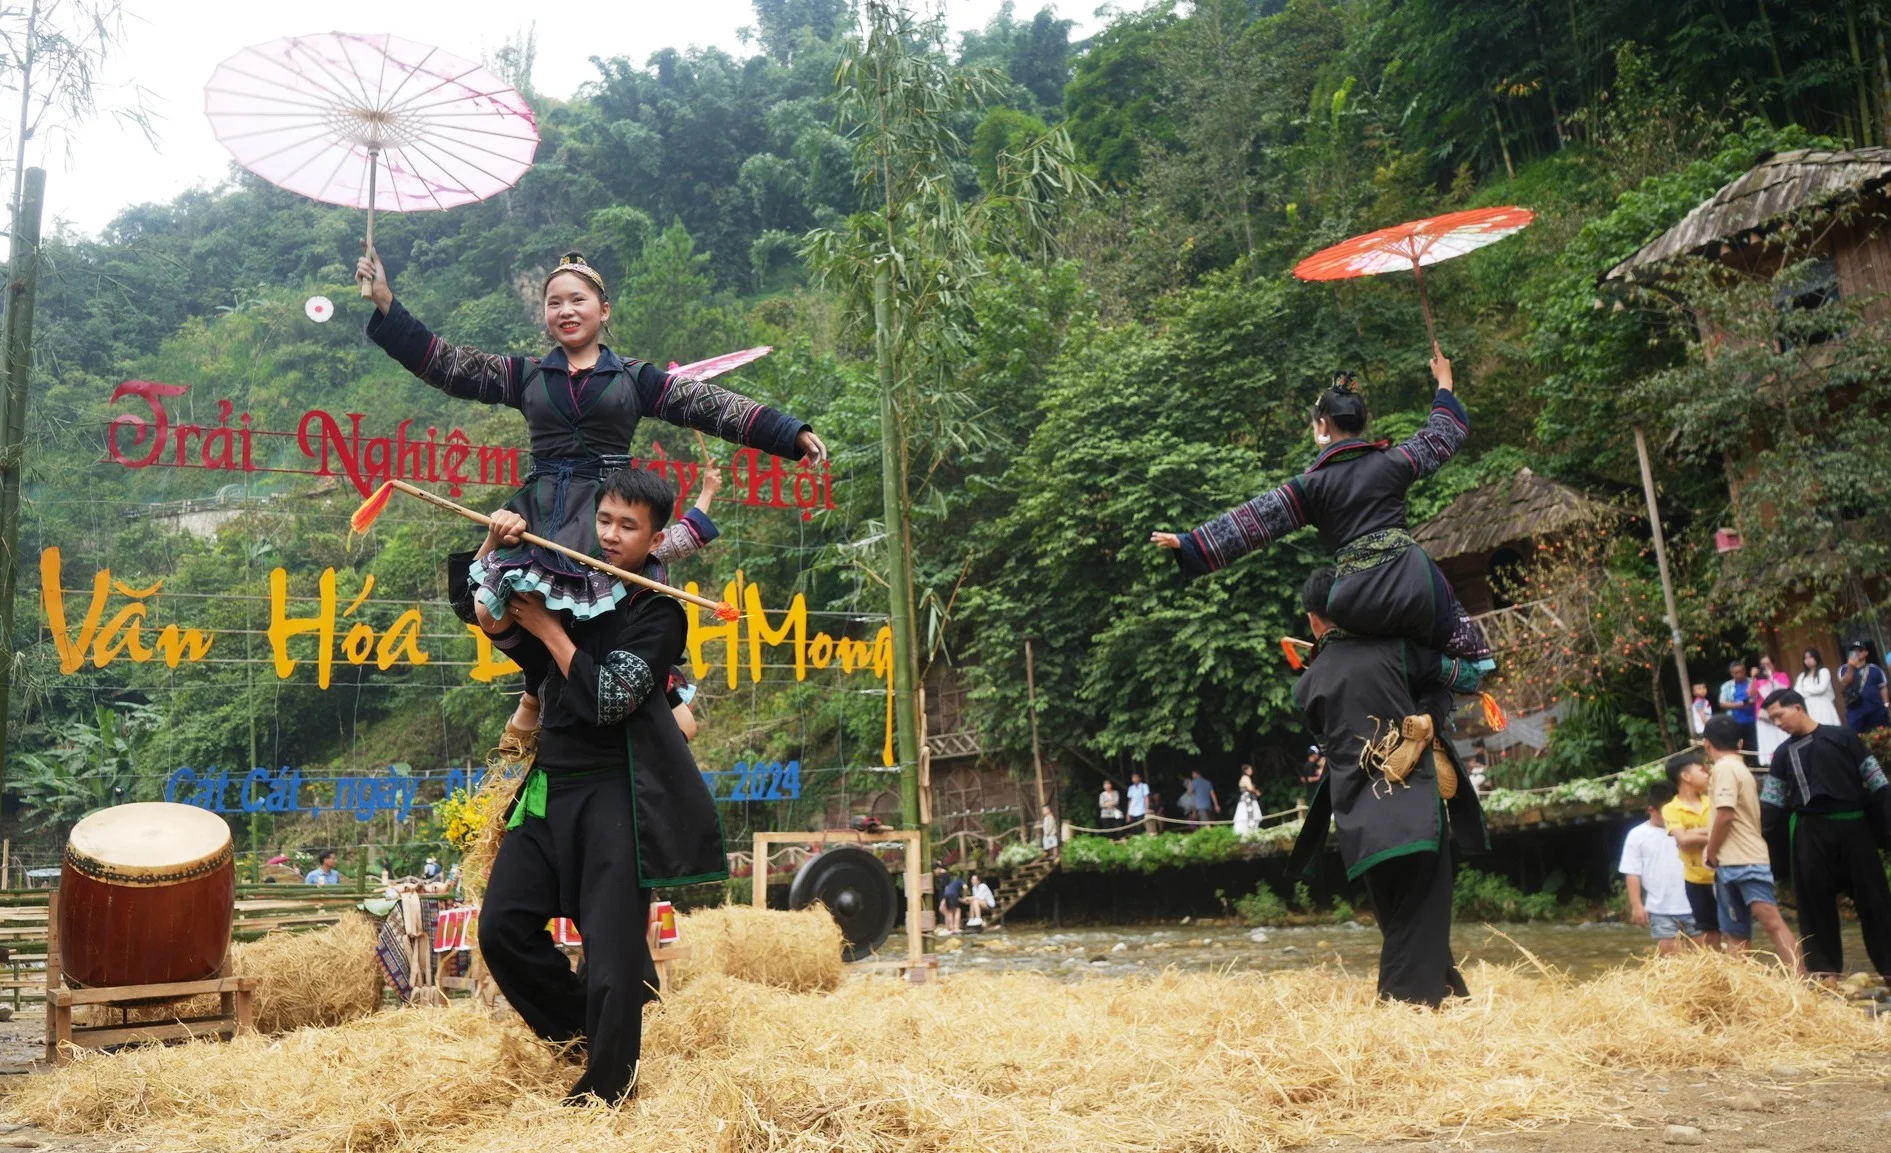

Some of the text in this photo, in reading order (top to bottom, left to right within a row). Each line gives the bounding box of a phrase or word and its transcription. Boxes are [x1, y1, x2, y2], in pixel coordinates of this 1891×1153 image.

[109, 379, 256, 473] Trải
[297, 409, 523, 500] Nghiệm
[732, 447, 837, 522] Hội
[40, 546, 214, 676] Văn
[267, 566, 429, 690] Hóa
[165, 765, 231, 813] Cát
[241, 765, 302, 813] Cát
[333, 764, 420, 822] ngày
[730, 760, 801, 802] 2024
